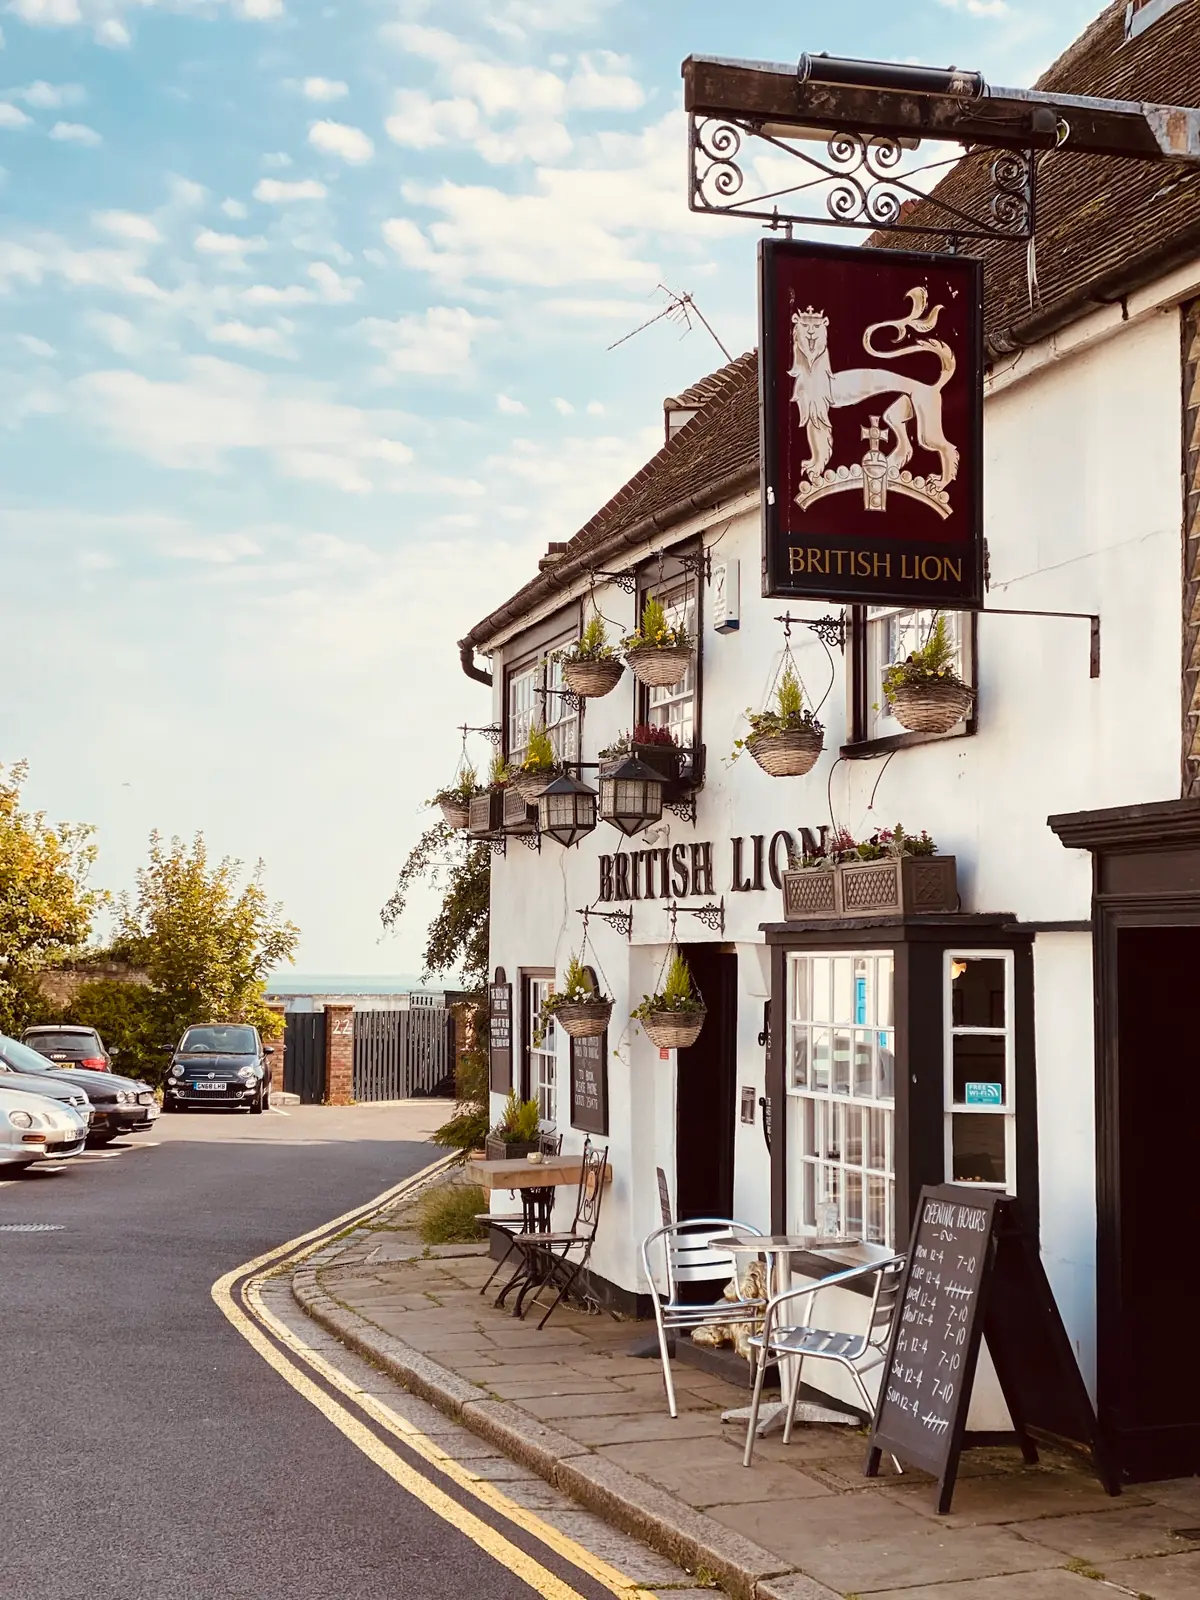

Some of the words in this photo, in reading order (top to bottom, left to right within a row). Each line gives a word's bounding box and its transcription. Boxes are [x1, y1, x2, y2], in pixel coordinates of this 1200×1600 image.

[788, 546, 891, 578] BRITISH
[900, 554, 962, 582] LION
[598, 841, 717, 902] BRITISH
[332, 1019, 353, 1035] 22
[923, 1203, 956, 1229] OPENING
[956, 1206, 987, 1232] HOURS
[930, 1249, 944, 1264] 12-4
[957, 1255, 976, 1274] 7-10
[926, 1271, 941, 1290] 12-4
[920, 1293, 936, 1311] 12-4
[947, 1305, 968, 1323] 7-10
[944, 1323, 966, 1346] 7-10
[910, 1337, 929, 1355] 12-4
[938, 1350, 961, 1372] 7-10
[891, 1359, 904, 1378] Sat
[904, 1368, 923, 1390] 12-4
[931, 1378, 954, 1404] 7-10
[899, 1395, 920, 1418] 12-4
